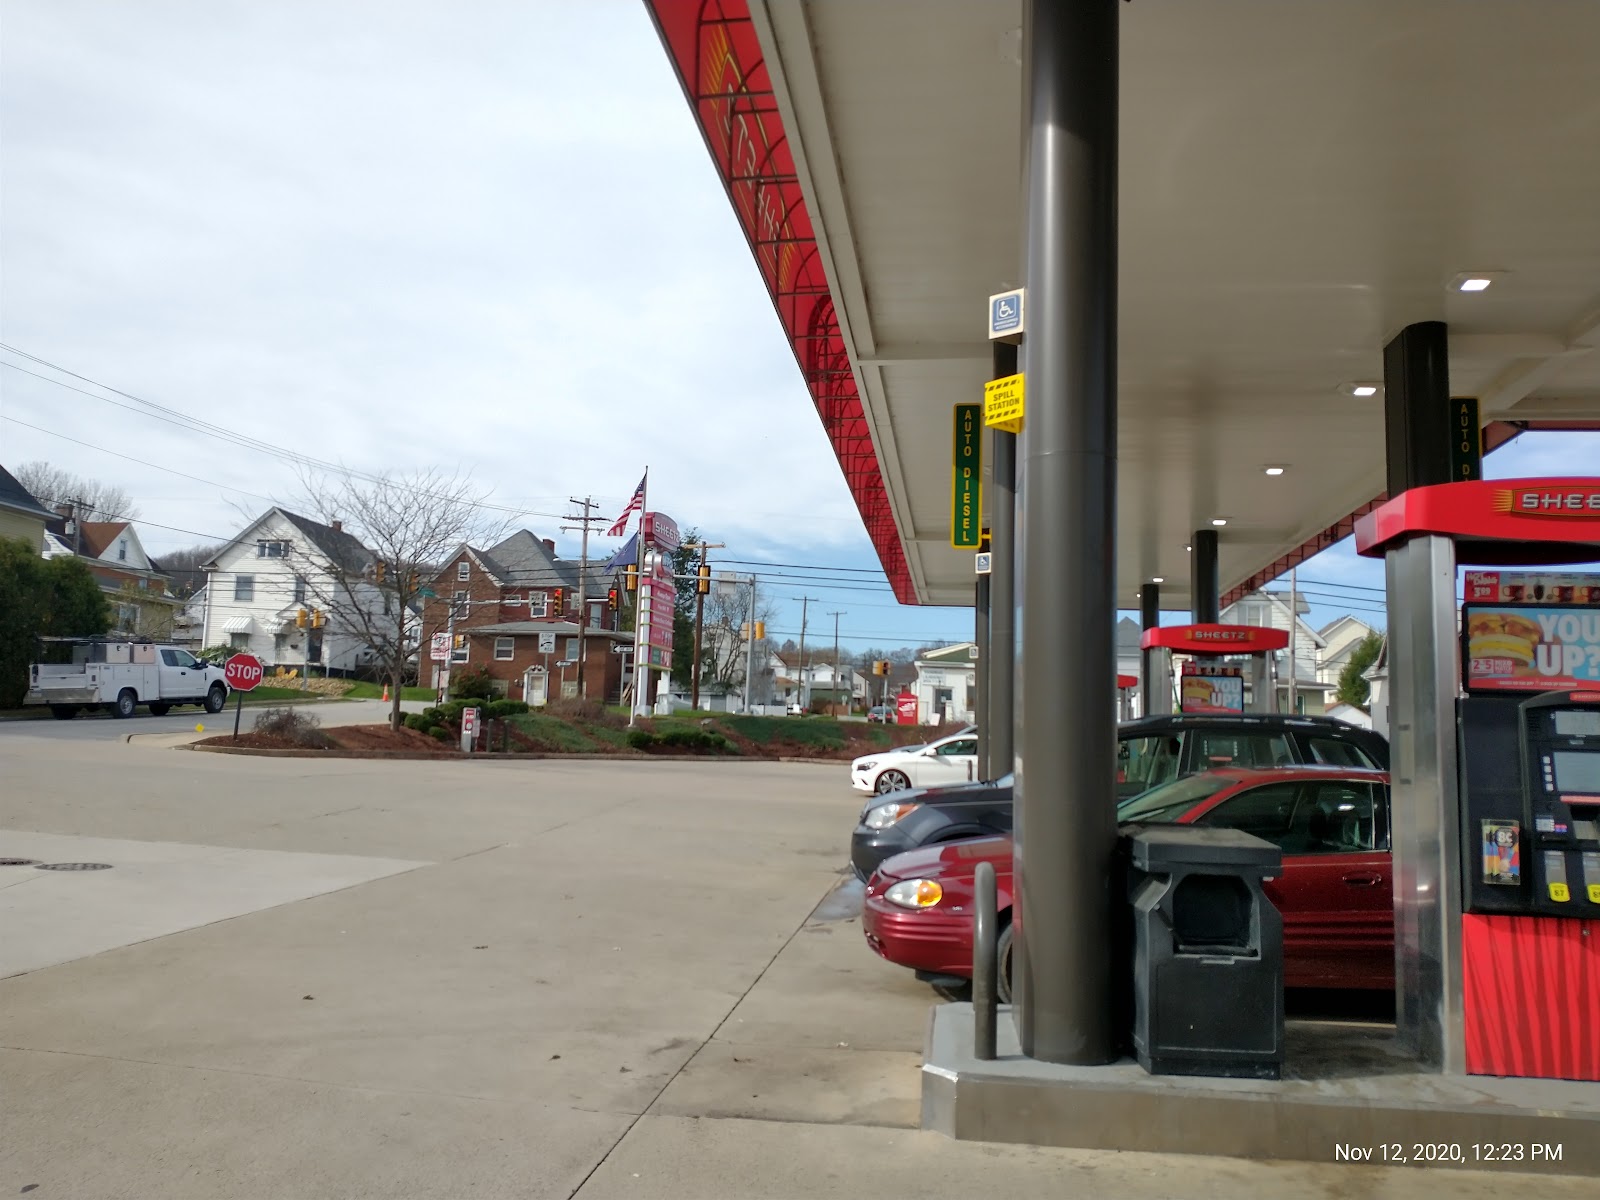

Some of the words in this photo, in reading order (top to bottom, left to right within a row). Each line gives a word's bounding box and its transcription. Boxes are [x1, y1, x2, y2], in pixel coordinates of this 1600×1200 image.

[993, 389, 1015, 402] SPILL
[988, 397, 1020, 412] STATION
[963, 409, 972, 457] AUTO
[1460, 404, 1471, 453] AUTO
[1462, 464, 1471, 481] D
[962, 467, 971, 542] DIESEL
[655, 521, 680, 543] SHEETZ
[1195, 631, 1246, 639] SHEETZ
[1537, 614, 1600, 643] YOU
[1537, 644, 1600, 677] UP?
[226, 663, 261, 681] STOP
[1213, 680, 1241, 692] YOU
[1211, 692, 1241, 707] UP?
[1555, 889, 1565, 897] 87
